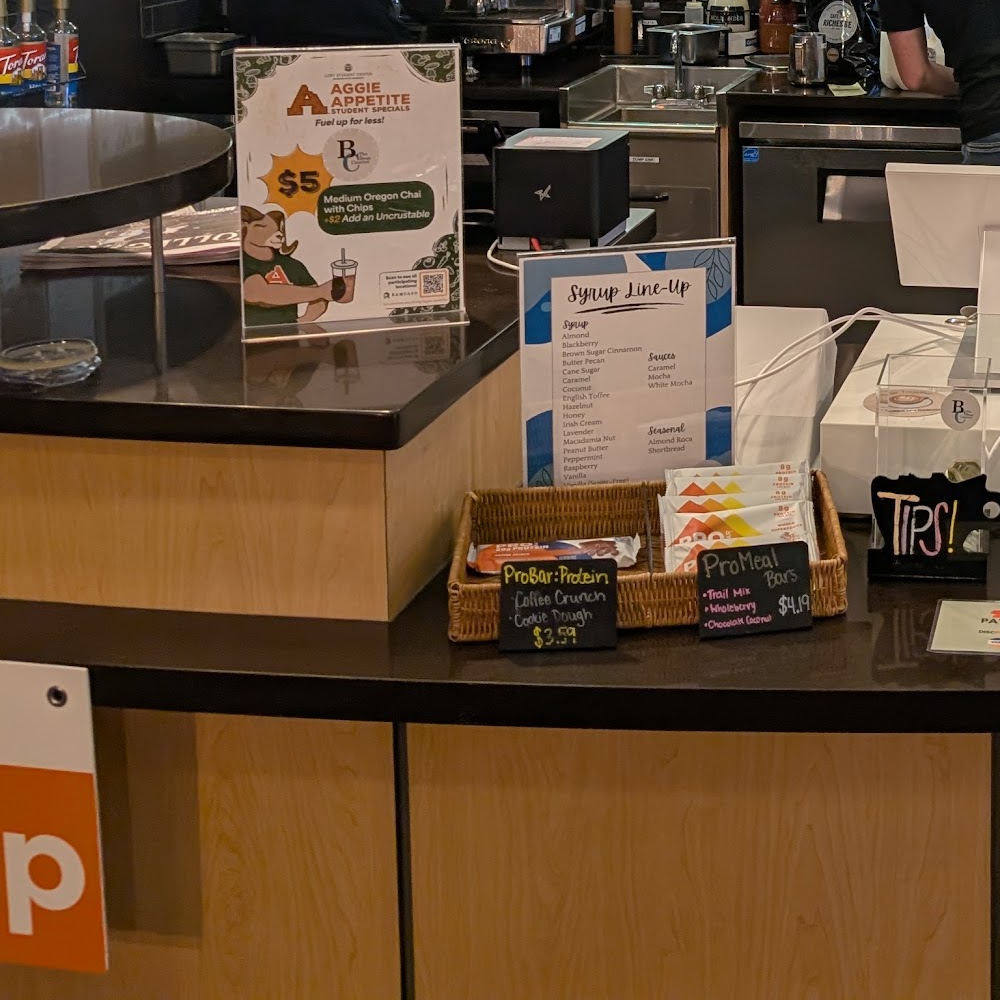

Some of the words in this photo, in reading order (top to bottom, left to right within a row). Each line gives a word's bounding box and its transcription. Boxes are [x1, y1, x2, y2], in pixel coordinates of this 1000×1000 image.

[330, 81, 381, 95] AGGIE
[331, 94, 410, 108] APPETITE
[331, 107, 370, 115] STUDENT
[315, 118, 335, 127] Fuel
[336, 118, 348, 127] up
[350, 117, 363, 126] for
[364, 116, 385, 125] less!
[278, 169, 320, 197] $5
[323, 192, 363, 204] Medium
[364, 191, 399, 204] Oregon
[400, 190, 422, 200] Chai
[323, 205, 345, 214] with
[346, 203, 374, 214] Chips
[324, 214, 341, 224] +$2
[341, 213, 361, 223] Add
[363, 214, 374, 222] an
[375, 209, 430, 221] Uncrustable
[568, 284, 621, 305] Syrup
[625, 278, 692, 299] Line-Up
[562, 319, 589, 330] Syrup
[648, 352, 677, 362] Sauces
[562, 376, 591, 384] Caramel
[562, 402, 593, 411] Hazelnut
[648, 423, 686, 435] Seasonal
[563, 463, 598, 473] Raspberry
[563, 472, 587, 480] Vanilla
[877, 491, 959, 556] TIPS!
[702, 546, 779, 578] ProMeal
[763, 568, 798, 589] Bars
[515, 590, 551, 611] Coffee
[555, 589, 606, 605] Crunch
[706, 588, 729, 600] Trail
[733, 588, 751, 598] Mix
[709, 601, 756, 614] Wholeberry
[778, 593, 810, 616] $4.19
[514, 612, 549, 628] Cookie
[552, 608, 593, 628] Dough
[707, 617, 744, 630] Chocolate
[745, 614, 772, 623] Coconut
[533, 626, 577, 648] $3.59
